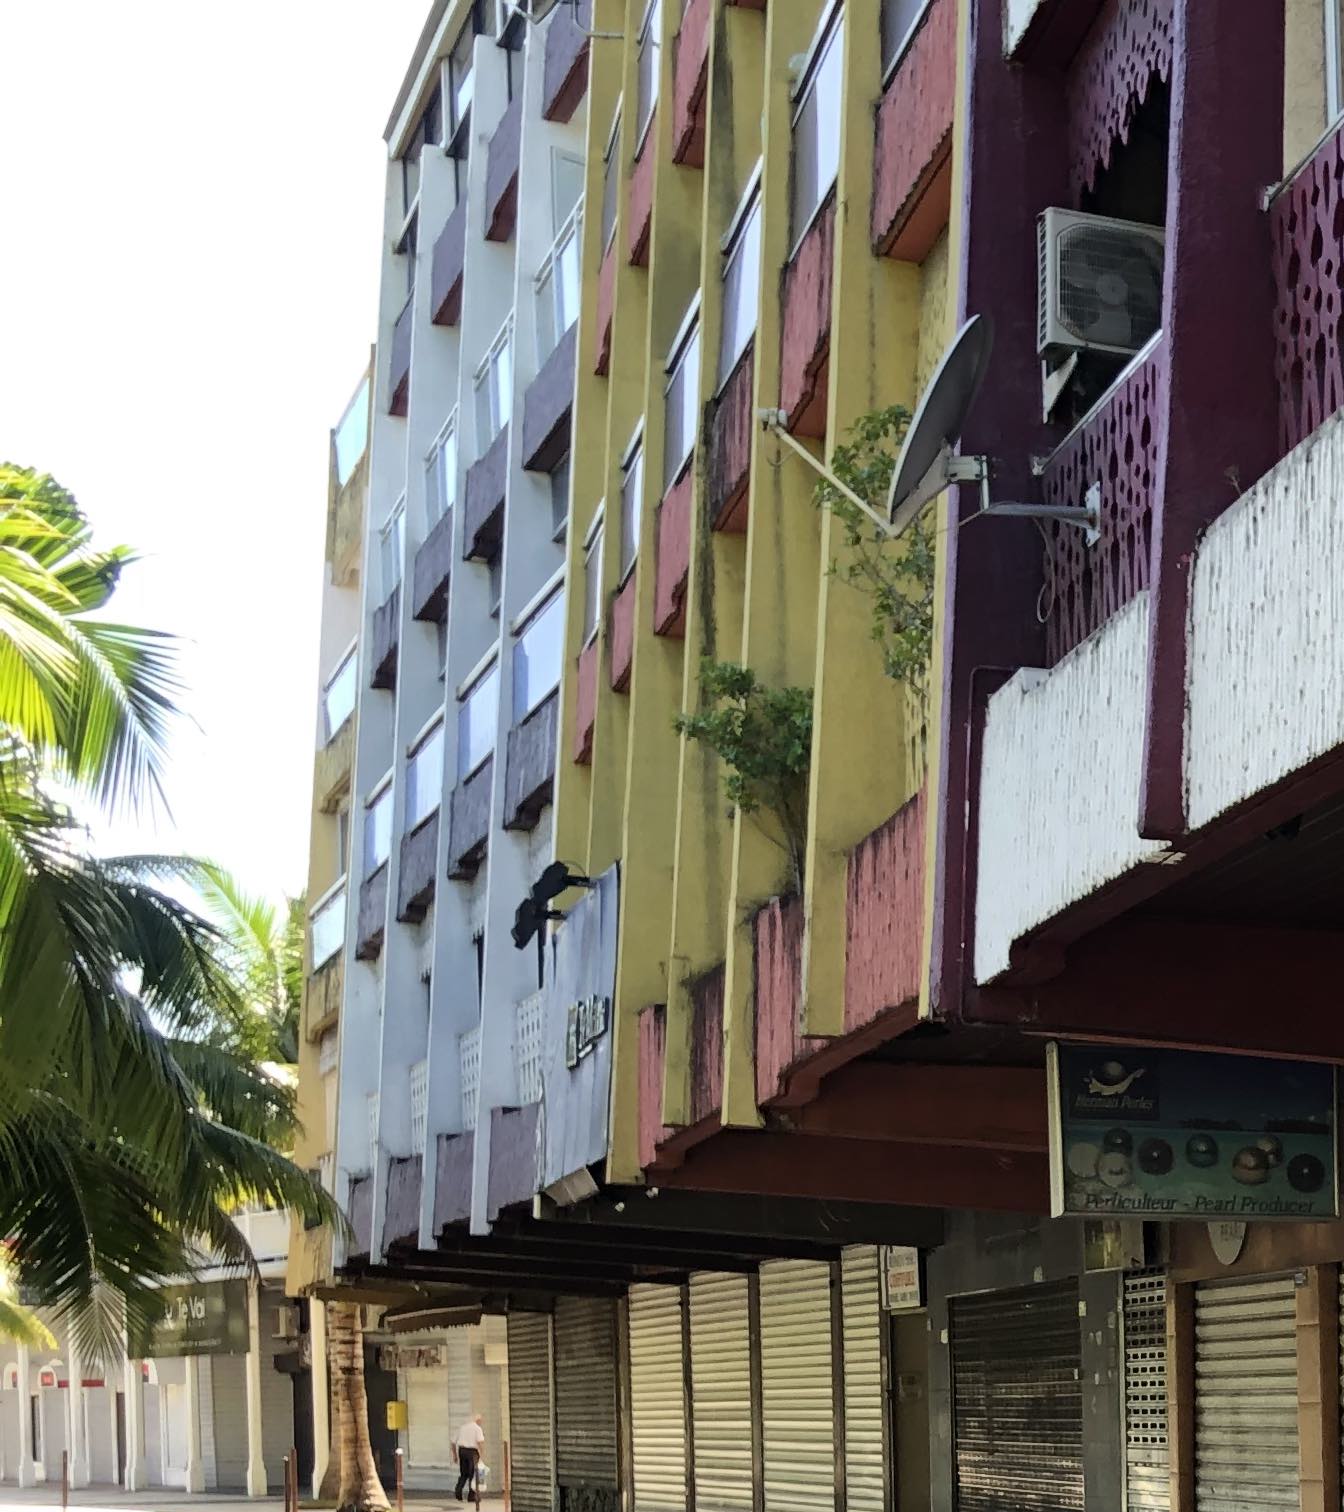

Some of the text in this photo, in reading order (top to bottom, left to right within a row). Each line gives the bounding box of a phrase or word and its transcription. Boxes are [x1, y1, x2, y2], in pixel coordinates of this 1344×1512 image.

[1085, 1192, 1178, 1211] Perliculteur
[1195, 1195, 1236, 1212] Pearl
[1240, 1195, 1316, 1213] Producer
[176, 1296, 188, 1320] Te
